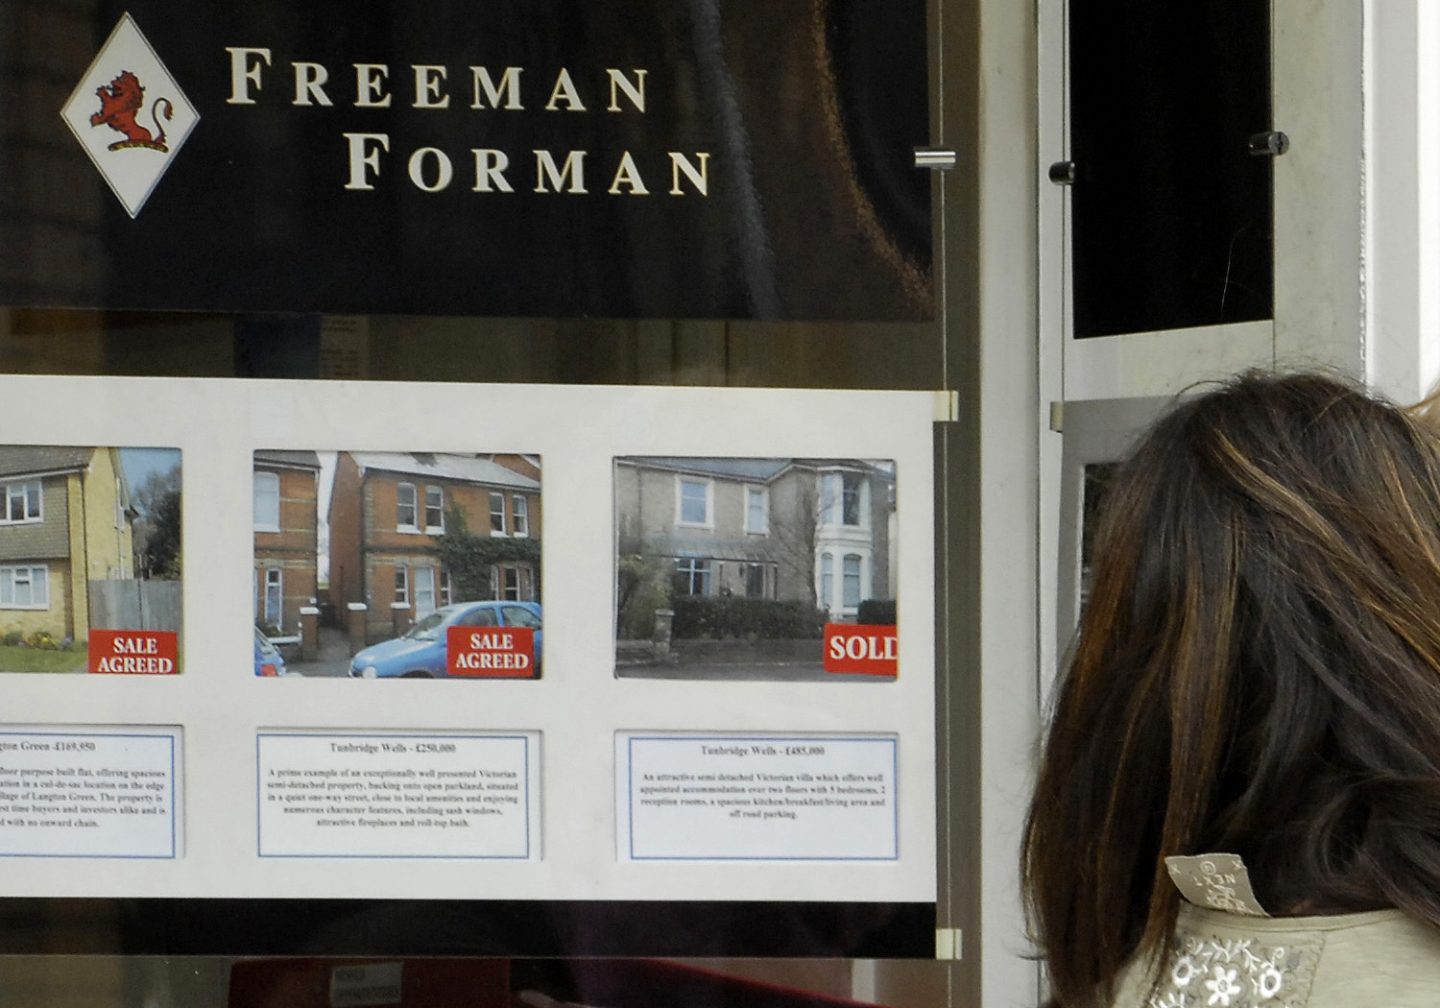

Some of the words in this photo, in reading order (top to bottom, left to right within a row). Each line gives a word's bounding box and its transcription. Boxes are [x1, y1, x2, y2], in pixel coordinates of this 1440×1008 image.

[225, 48, 647, 111] FREEMAN
[343, 133, 710, 195] FORMAN
[114, 638, 157, 653] SALE
[471, 634, 513, 654] SALE
[98, 657, 172, 673] AGREED
[456, 653, 528, 668] AGREED
[20, 742, 49, 750] Green
[331, 743, 379, 754] Tunbridge
[382, 744, 407, 752] Wells
[702, 746, 748, 757] Tunbridge
[751, 746, 776, 755] Wells
[304, 770, 337, 778] example
[363, 769, 416, 778] exceptionally
[437, 771, 476, 779] presented
[867, 774, 883, 782] well
